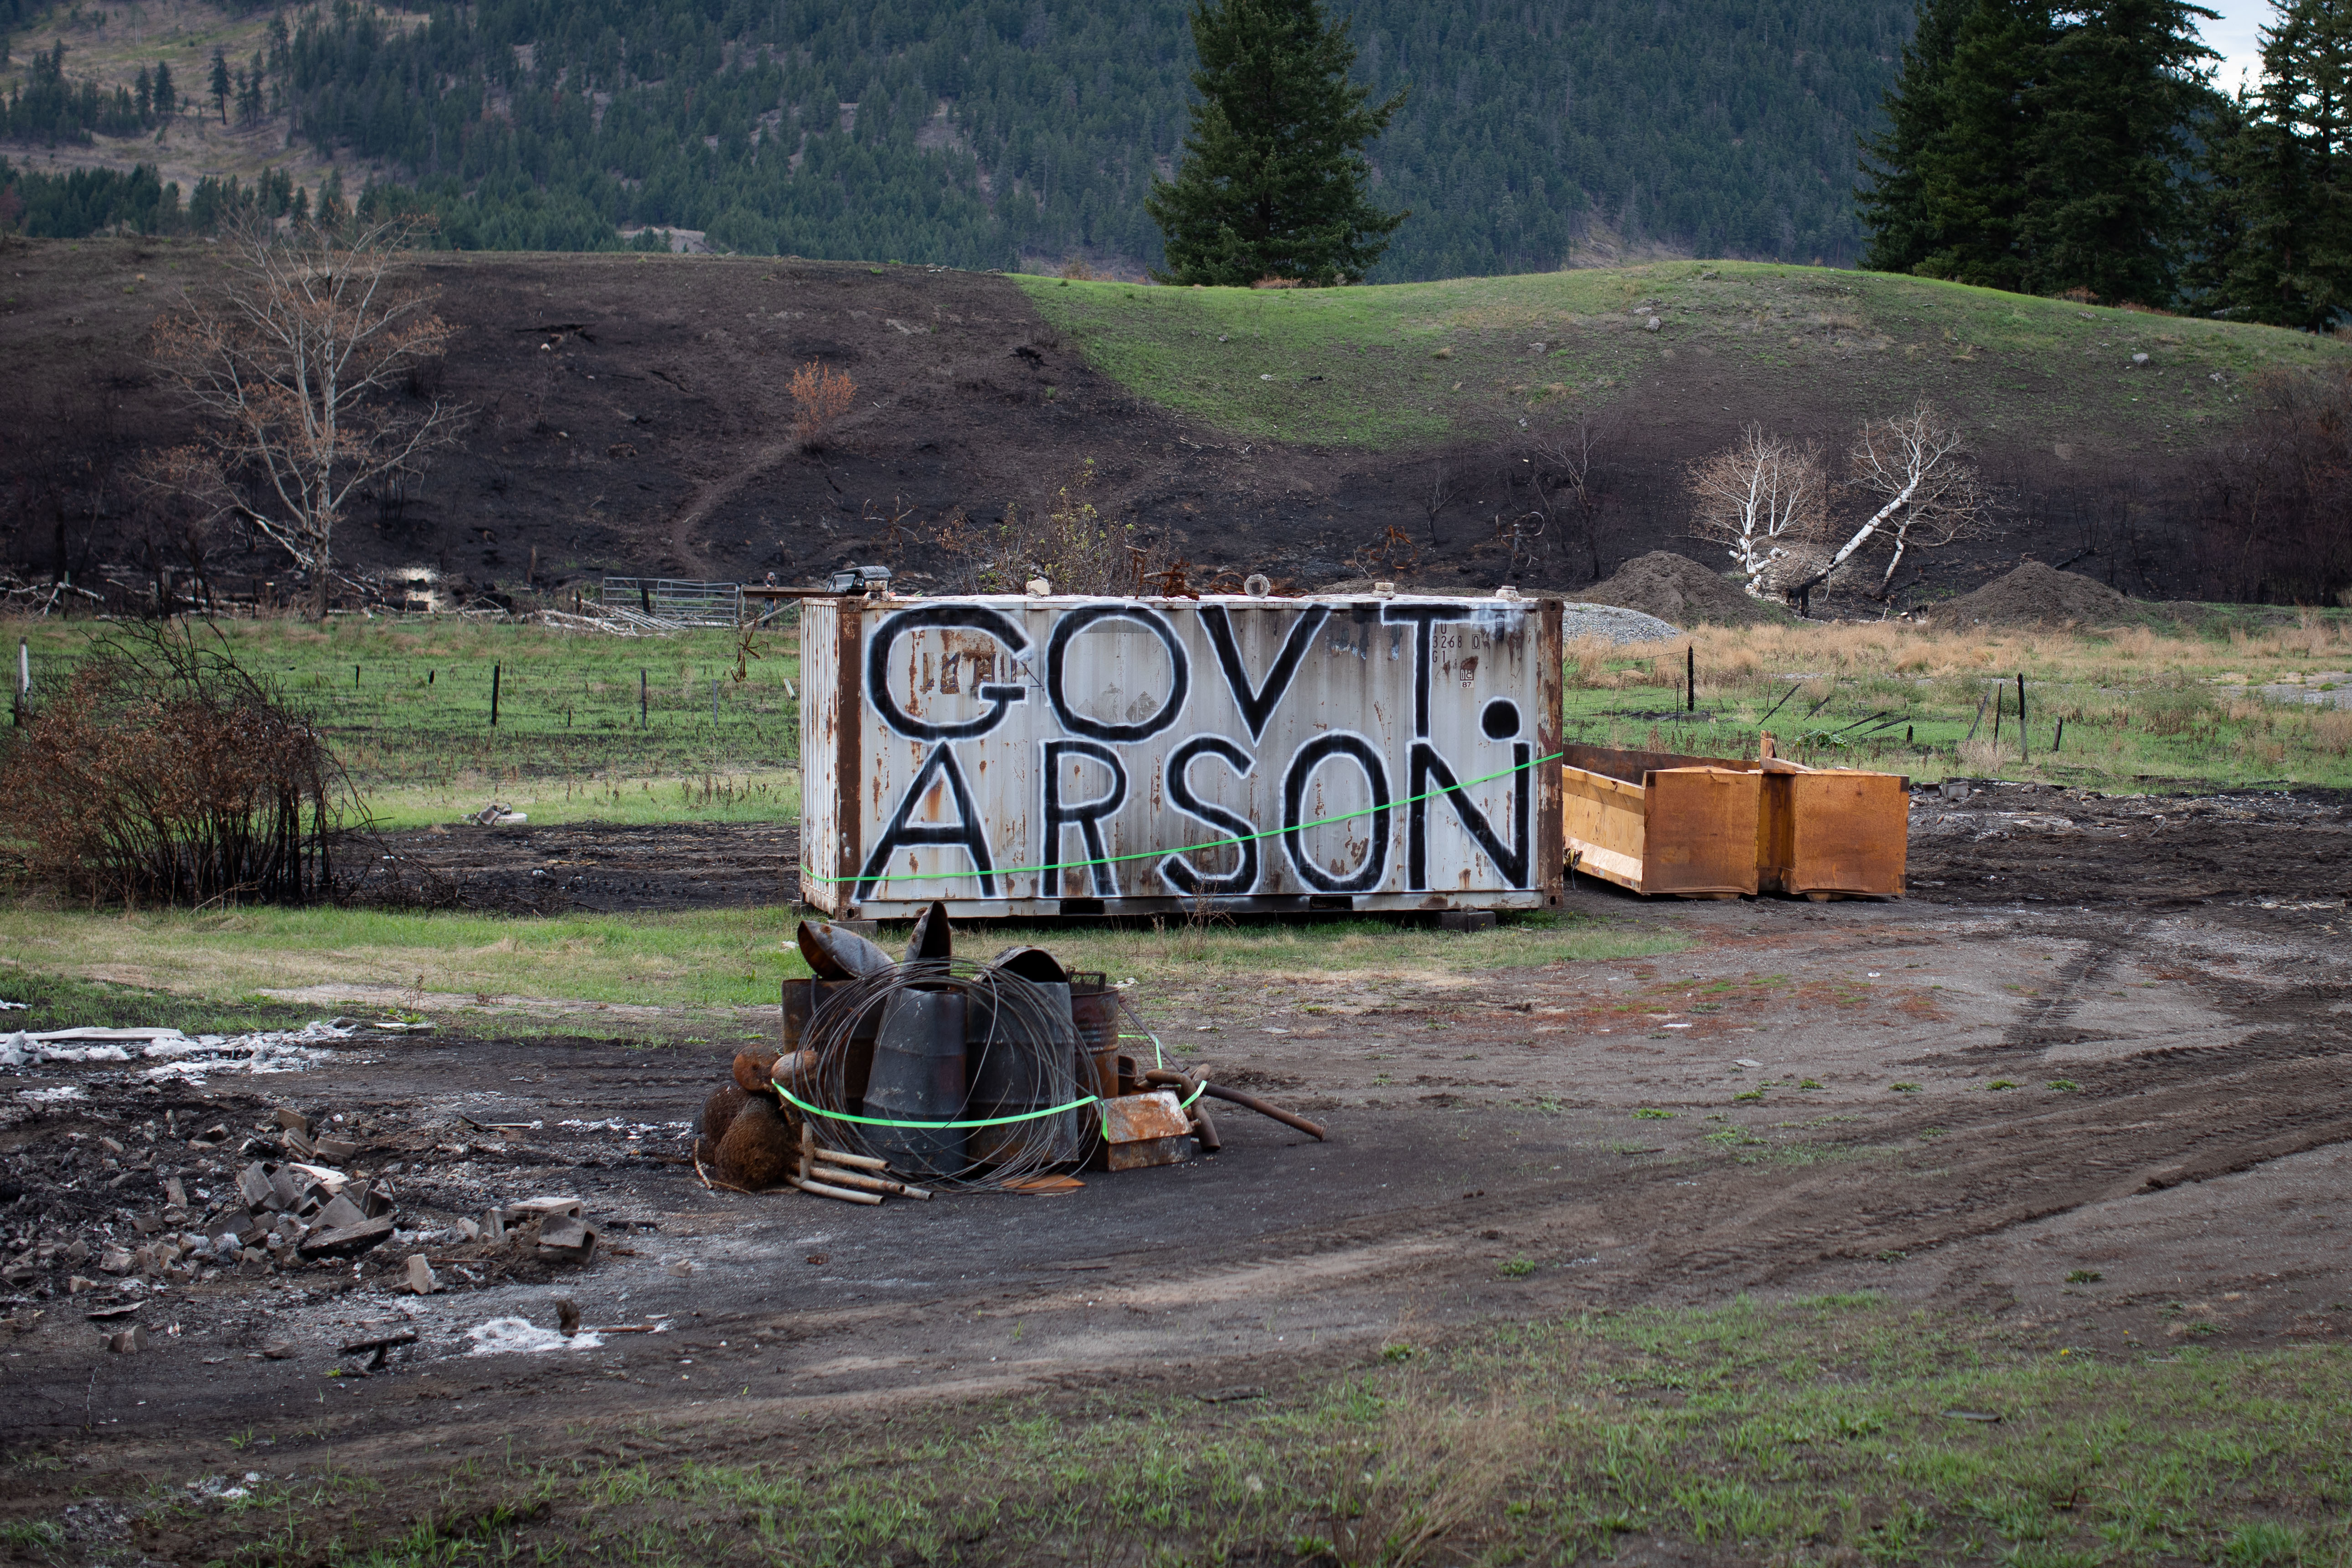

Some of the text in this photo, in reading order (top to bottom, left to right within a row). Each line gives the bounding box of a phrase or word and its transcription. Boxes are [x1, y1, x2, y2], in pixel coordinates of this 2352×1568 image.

[868, 604, 1521, 745] GOVT.
[1432, 650, 1445, 663] G1
[1433, 635, 1479, 649] 3268 0
[856, 732, 1532, 897] ARSON
